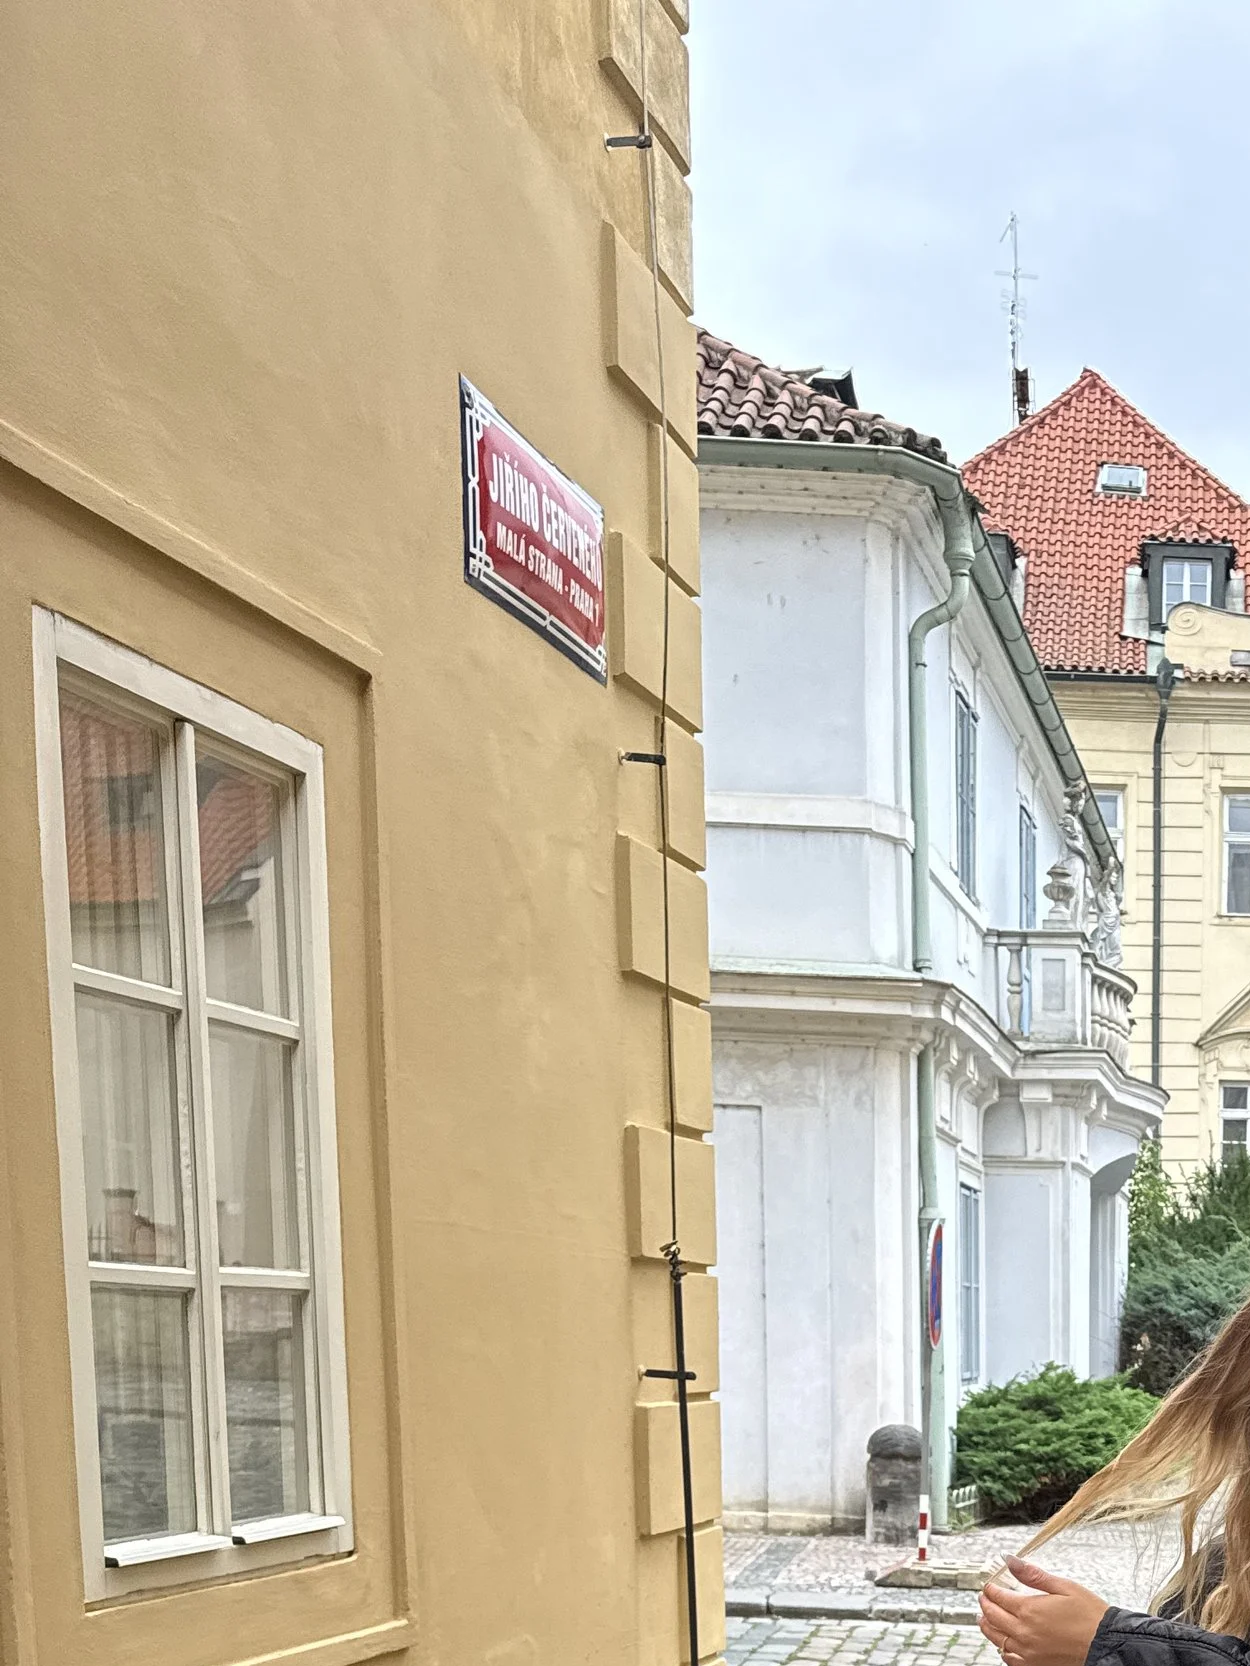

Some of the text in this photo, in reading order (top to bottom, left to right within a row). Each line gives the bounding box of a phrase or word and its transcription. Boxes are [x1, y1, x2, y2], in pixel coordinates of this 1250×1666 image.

[489, 452, 603, 591] JIŘÍHO ČERVENÉHO
[496, 521, 526, 566] MALÁ
[528, 544, 563, 595] STRANA
[569, 579, 594, 624] PRAHA
[595, 603, 599, 627] 1
